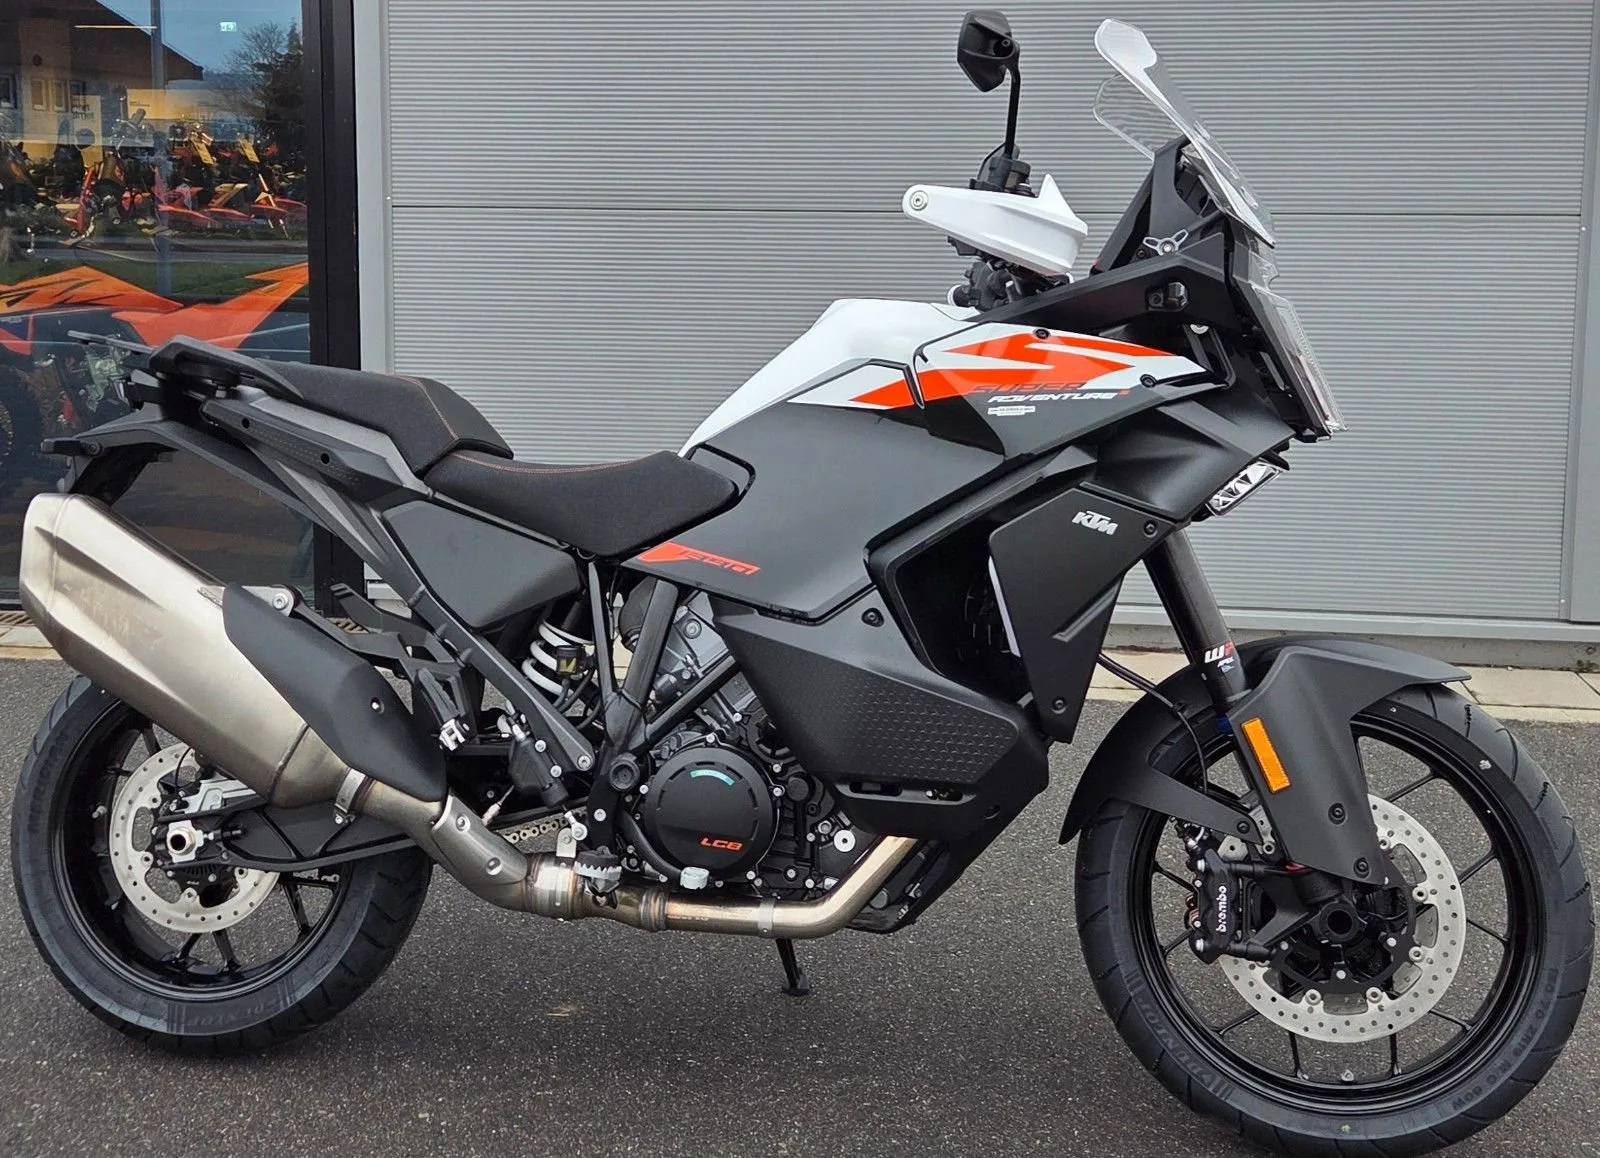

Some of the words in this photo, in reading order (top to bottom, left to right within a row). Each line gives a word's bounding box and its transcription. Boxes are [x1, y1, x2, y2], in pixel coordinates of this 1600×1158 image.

[988, 392, 1118, 402] ADVENTURE
[1071, 510, 1118, 536] KTM
[700, 837, 743, 851] LC8
[1215, 885, 1227, 933] brembo
